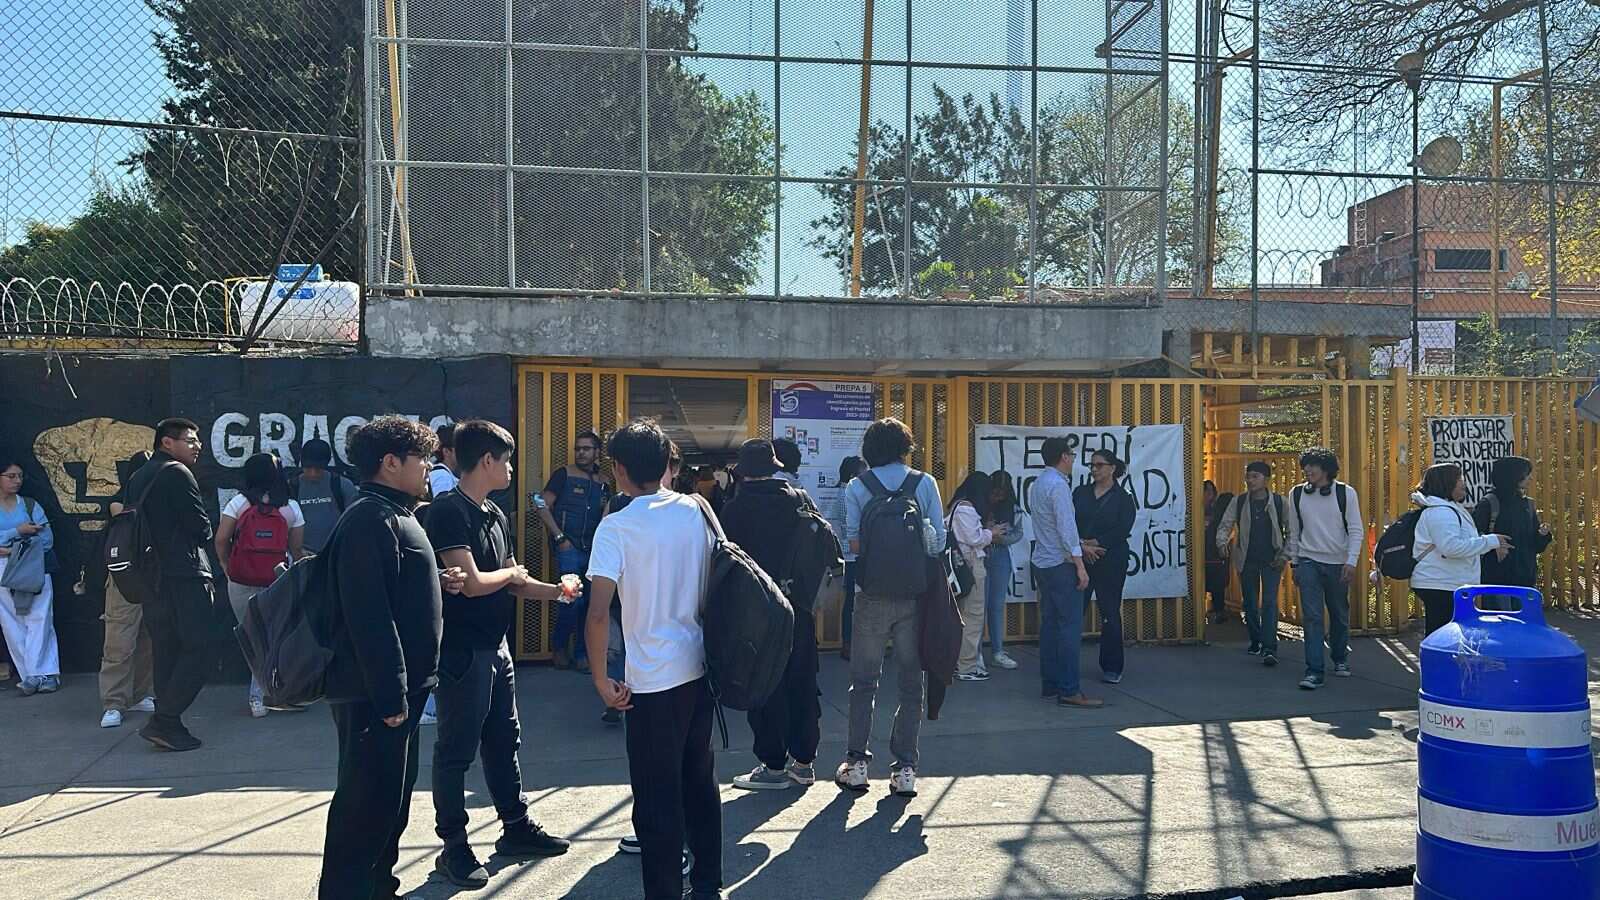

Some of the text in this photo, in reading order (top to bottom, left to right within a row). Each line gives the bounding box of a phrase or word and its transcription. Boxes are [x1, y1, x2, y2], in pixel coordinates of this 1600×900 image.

[835, 384, 861, 392] PREPA
[210, 412, 454, 468] GRAC
[1431, 418, 1506, 441] PROTESTAR
[980, 435, 1047, 470] TE
[1434, 442, 1450, 459] ES
[1452, 440, 1471, 459] UN
[1425, 711, 1465, 729] CDMX
